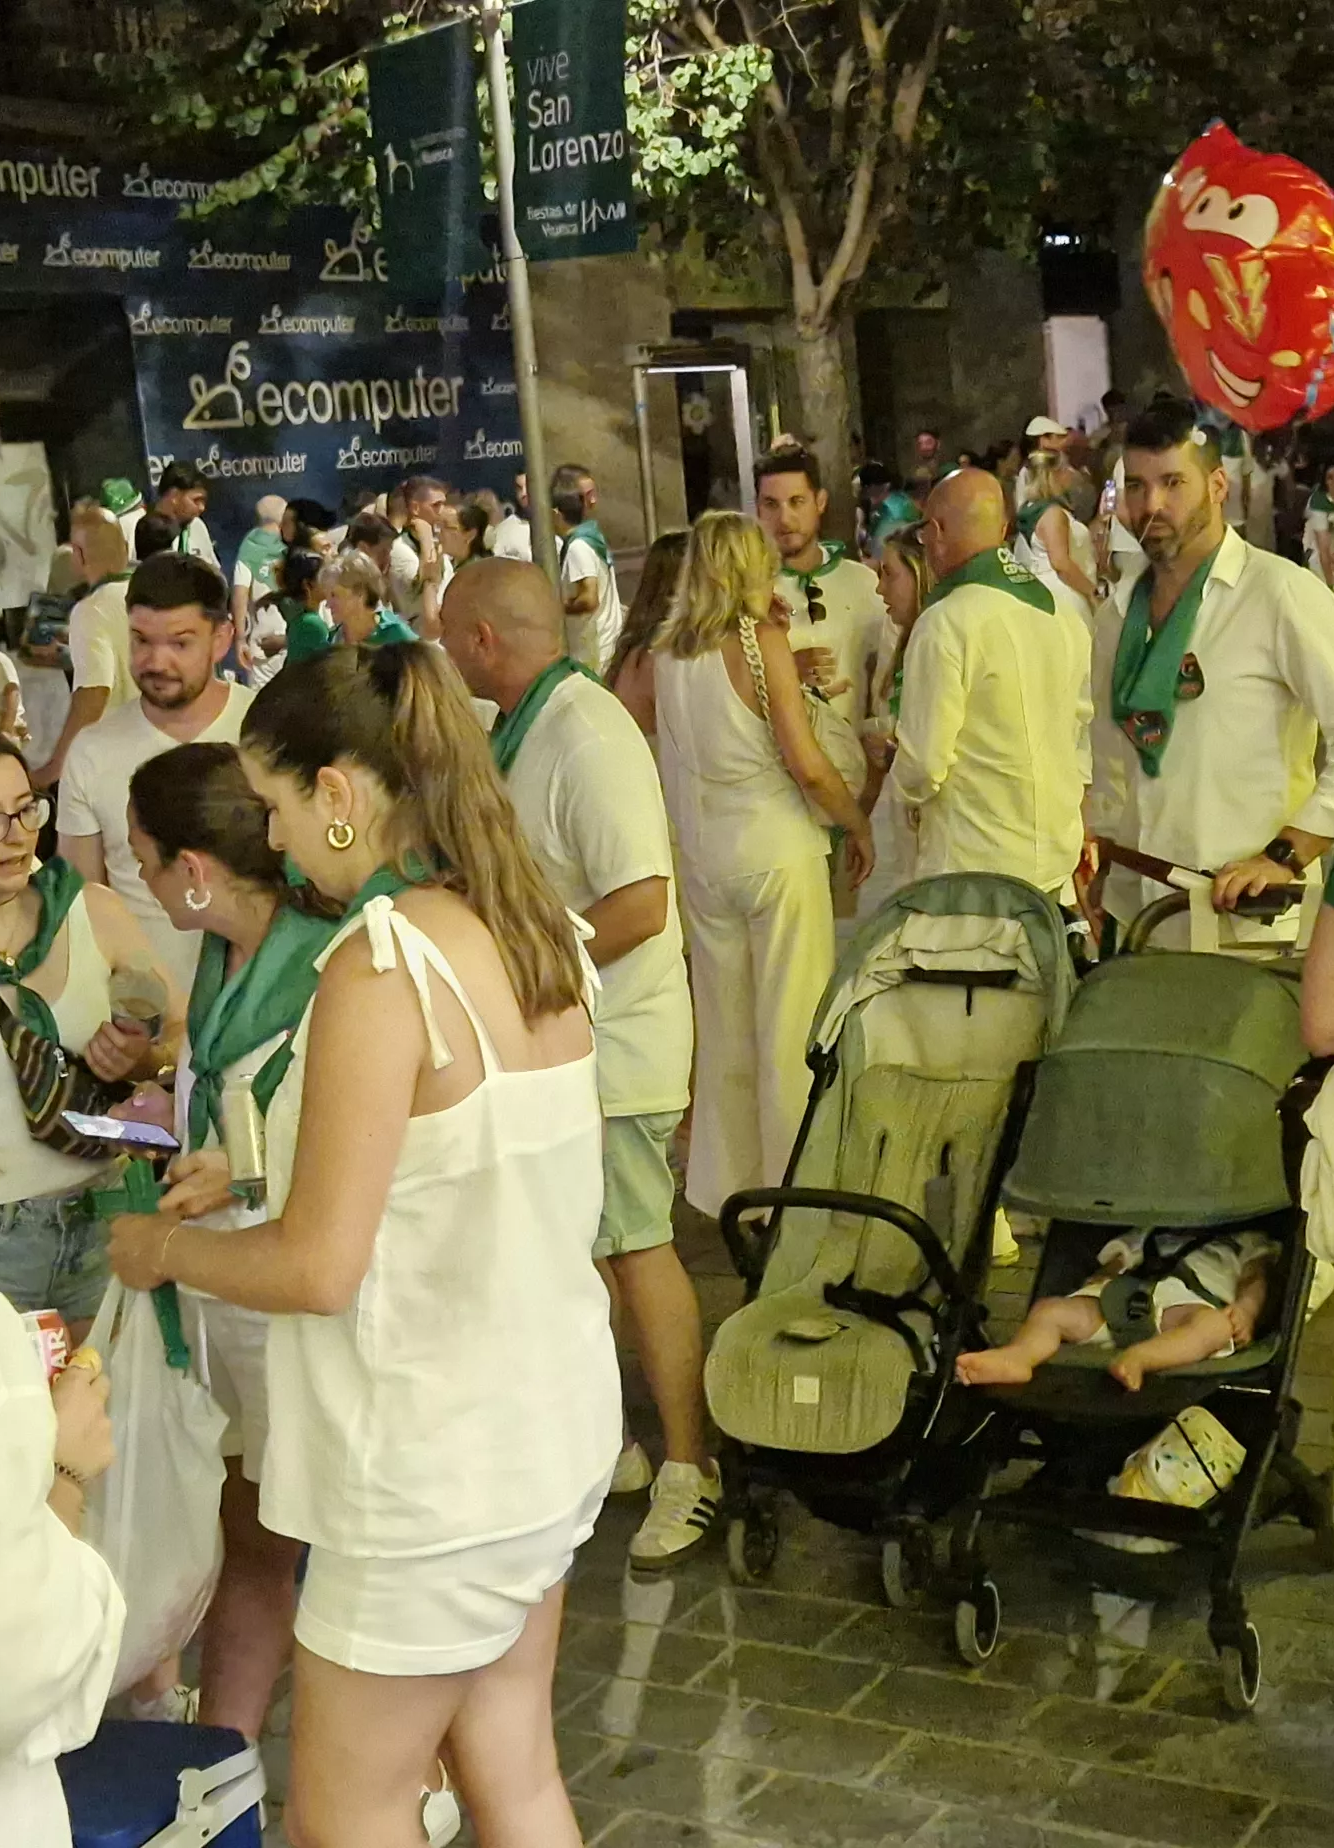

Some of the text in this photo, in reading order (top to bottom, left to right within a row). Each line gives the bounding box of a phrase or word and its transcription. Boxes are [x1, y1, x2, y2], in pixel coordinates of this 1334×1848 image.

[527, 51, 569, 86] vive
[527, 90, 570, 130] San
[528, 130, 624, 174] Lorenzo
[71, 247, 162, 271] ecomputer
[281, 313, 356, 337] ecomputer
[255, 365, 465, 433] ecomputer
[221, 450, 308, 479] ecomputer
